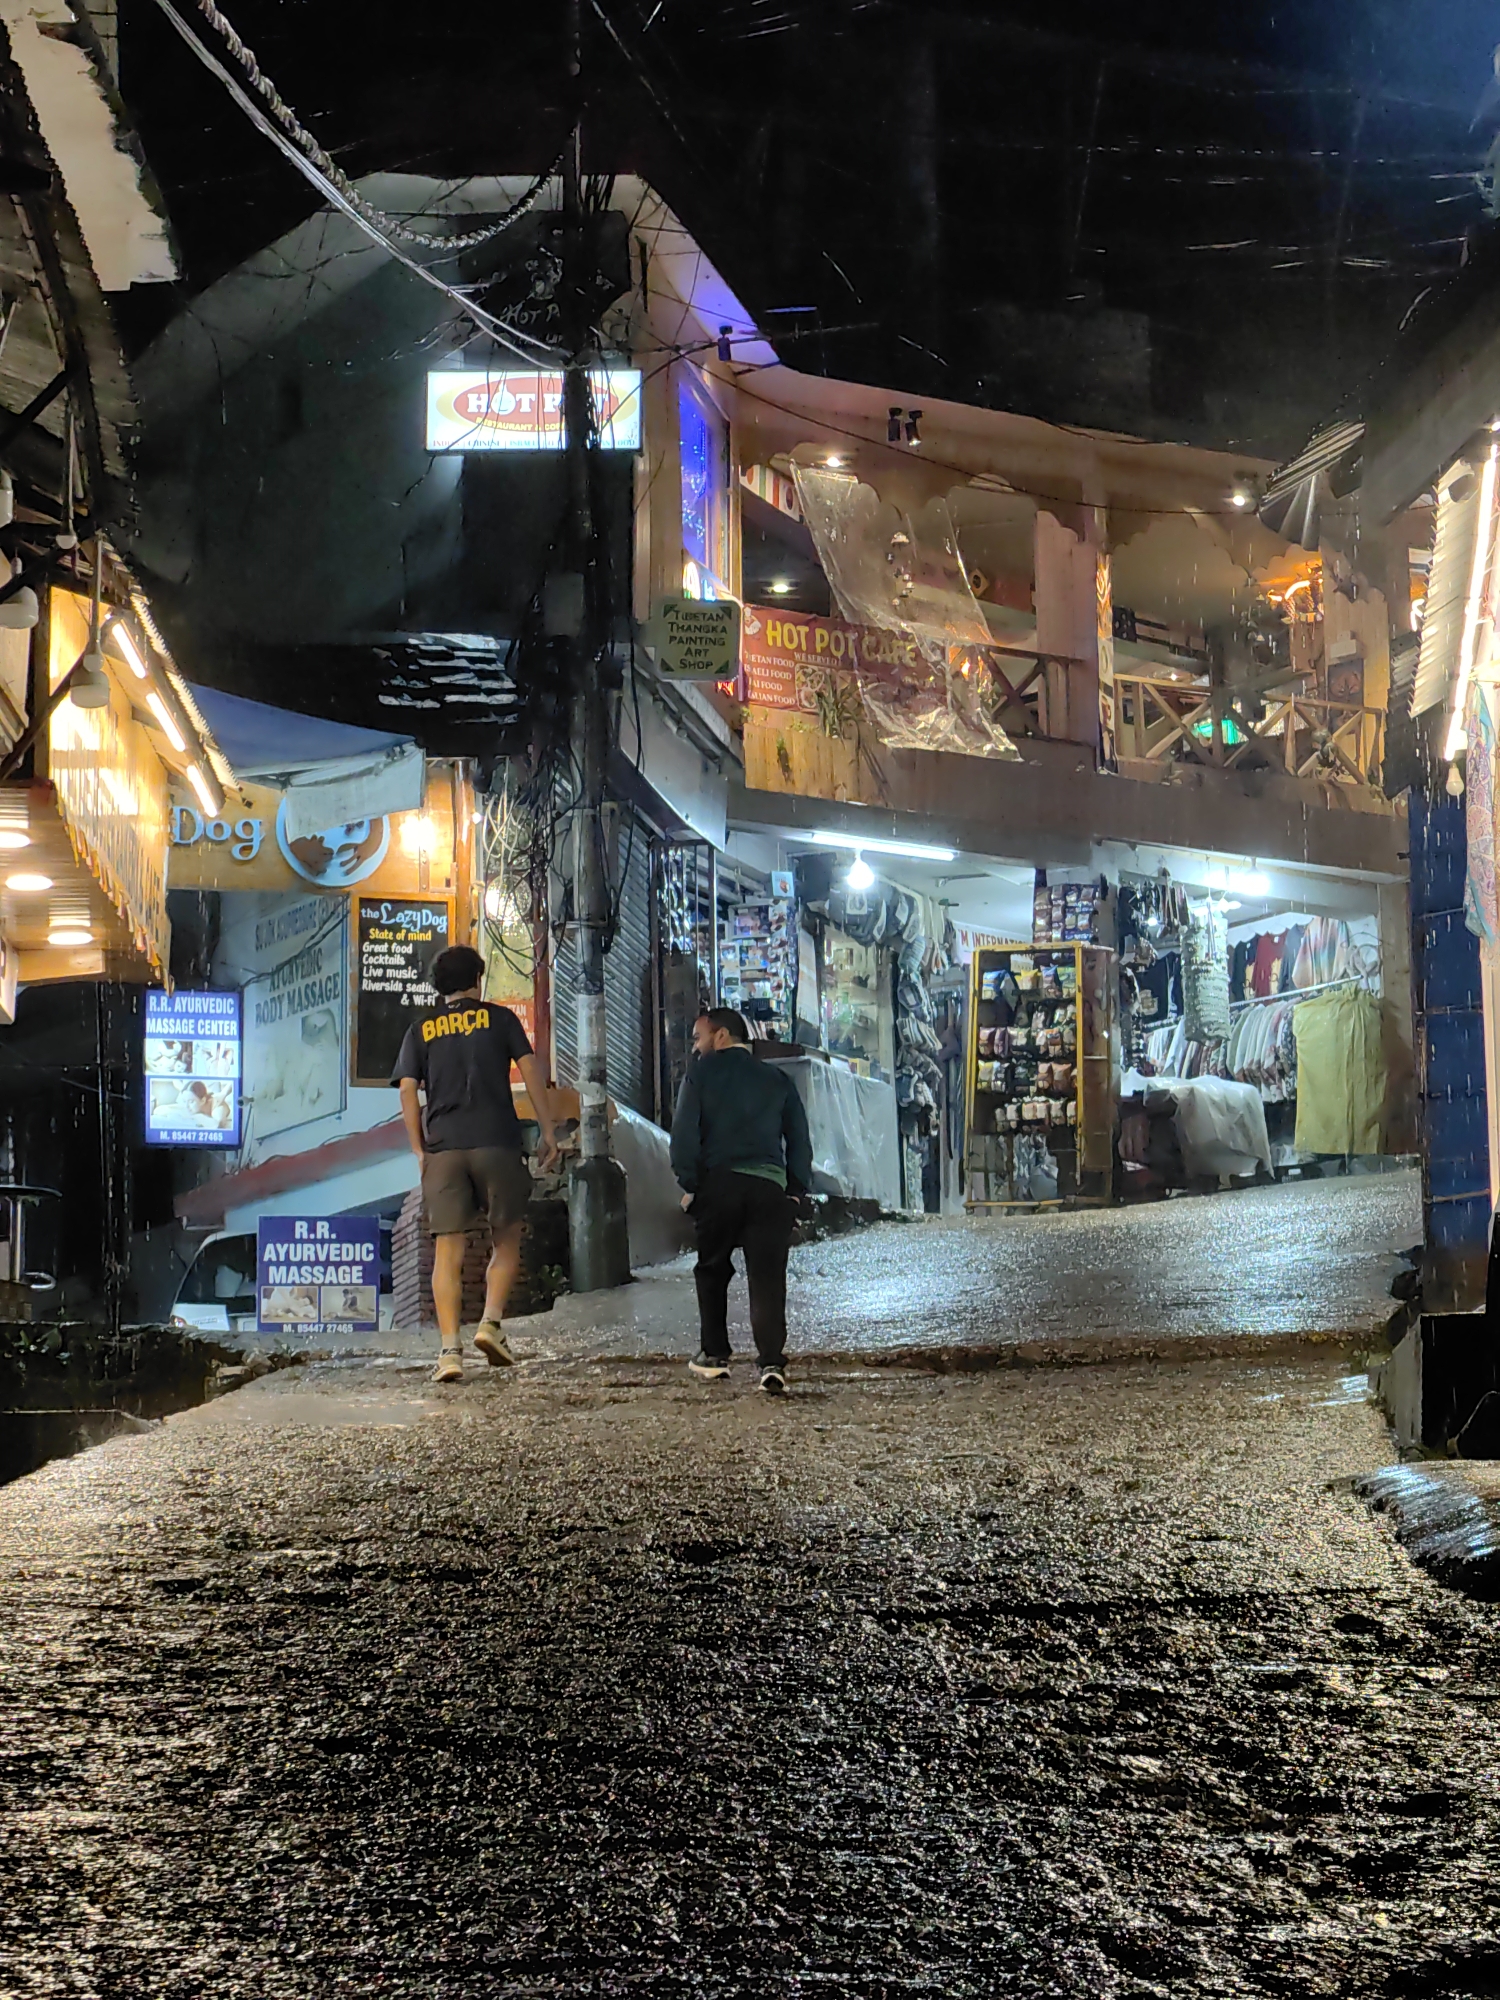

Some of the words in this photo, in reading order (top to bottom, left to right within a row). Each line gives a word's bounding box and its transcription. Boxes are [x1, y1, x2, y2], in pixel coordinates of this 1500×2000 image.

[467, 388, 536, 415] HOT
[674, 609, 724, 622] TIBETAN
[668, 622, 728, 635] THANGKA
[669, 635, 726, 646] PAINTING
[766, 619, 809, 651] HOT
[815, 627, 858, 659] POT
[685, 647, 709, 658] ART
[679, 658, 714, 670] SHOP
[773, 657, 794, 668] FOOD
[770, 669, 792, 680] FOOD
[761, 681, 783, 691] FOOD
[773, 694, 795, 705] FOOD
[172, 806, 266, 860] Dog
[361, 908, 380, 919] the
[380, 903, 421, 932] Lazy
[422, 909, 448, 933] Dog
[369, 928, 393, 940] State
[396, 929, 406, 941] of
[408, 930, 432, 941] mind
[362, 942, 389, 953] Great
[391, 943, 413, 954] food
[362, 954, 405, 965] Cocktails
[363, 966, 383, 977] Live
[386, 966, 418, 979] music
[362, 979, 403, 992] Riverside
[149, 995, 172, 1012] R.R.
[174, 997, 234, 1014] AYURVEDIC
[255, 993, 285, 1028] BODY
[286, 972, 340, 1018] MASSAGE
[401, 993, 409, 1006] &
[413, 994, 436, 1006] Wi-Fi
[146, 1018, 195, 1035] MASSAGE
[197, 1019, 238, 1036] CENTER
[422, 1009, 490, 1042] BARÇA
[160, 1131, 170, 1140] M.
[172, 1131, 196, 1141] 85447
[294, 1221, 337, 1239] R.R.
[263, 1243, 375, 1261] AYURVEDIC
[268, 1266, 363, 1284] MASSAGE
[283, 1324, 295, 1333] M.
[326, 1324, 353, 1334] 27465
